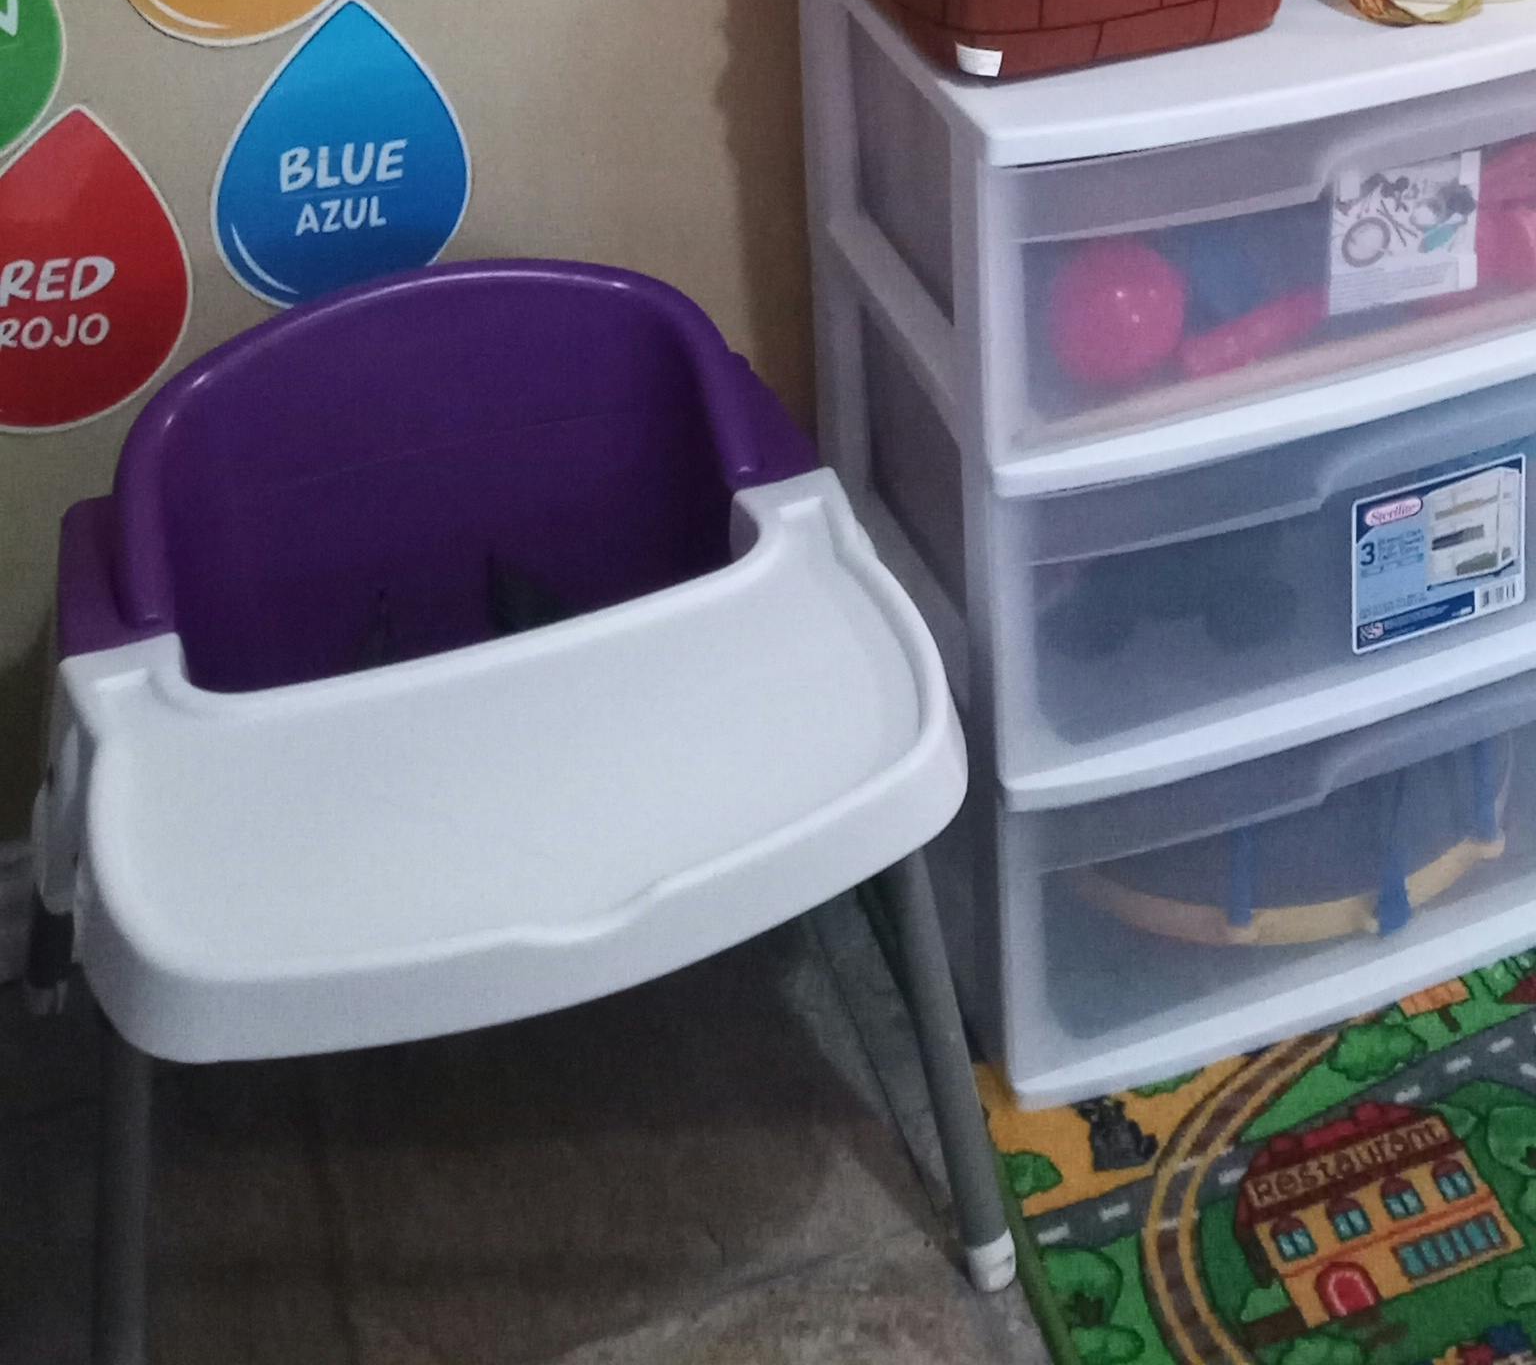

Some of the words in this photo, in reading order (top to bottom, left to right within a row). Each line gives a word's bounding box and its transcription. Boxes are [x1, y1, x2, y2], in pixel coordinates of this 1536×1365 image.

[278, 137, 410, 197] BLUE
[294, 199, 389, 239] AZUL
[1360, 541, 1376, 567] 3
[1252, 1121, 1443, 1202] Restaurant
